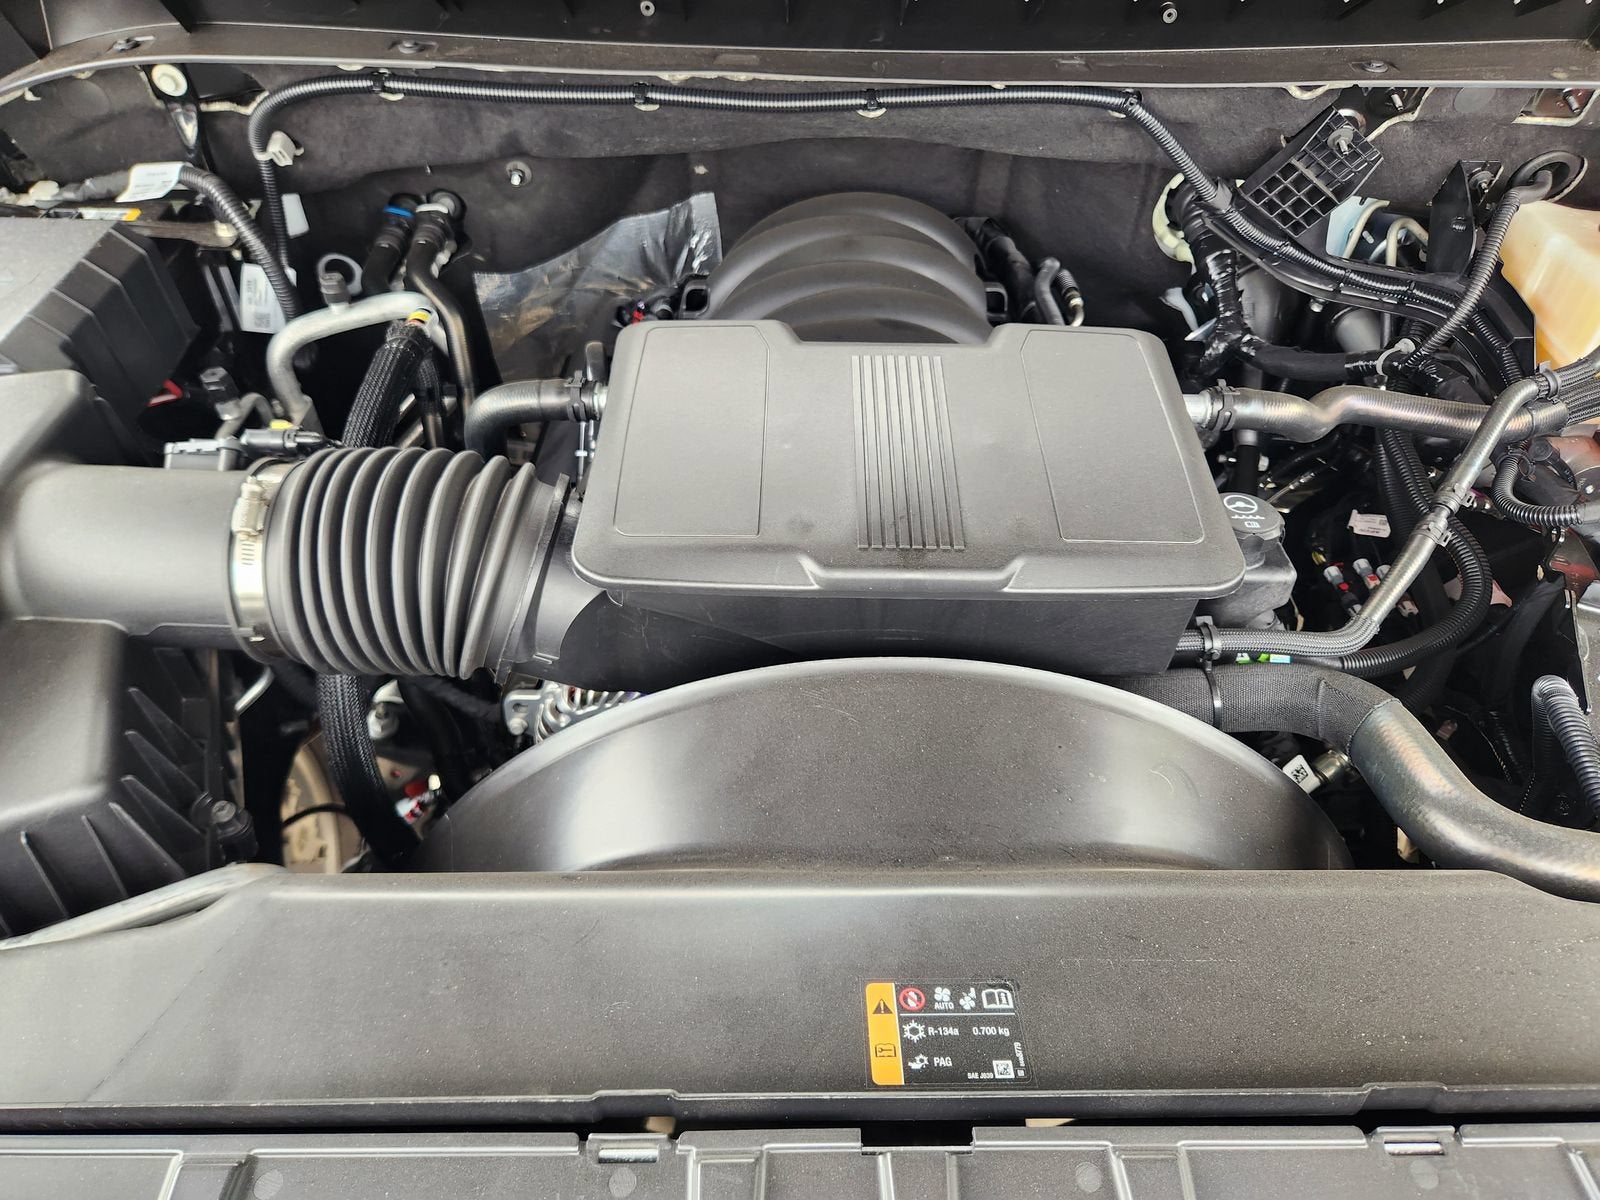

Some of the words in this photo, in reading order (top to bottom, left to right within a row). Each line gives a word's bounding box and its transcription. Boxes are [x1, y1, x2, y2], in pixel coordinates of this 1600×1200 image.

[934, 1002, 954, 1010] AUTO
[928, 1027, 959, 1036] R-134a
[973, 1027, 997, 1036] 0.700
[998, 1027, 1010, 1037] kg
[933, 1057, 952, 1067] PAG
